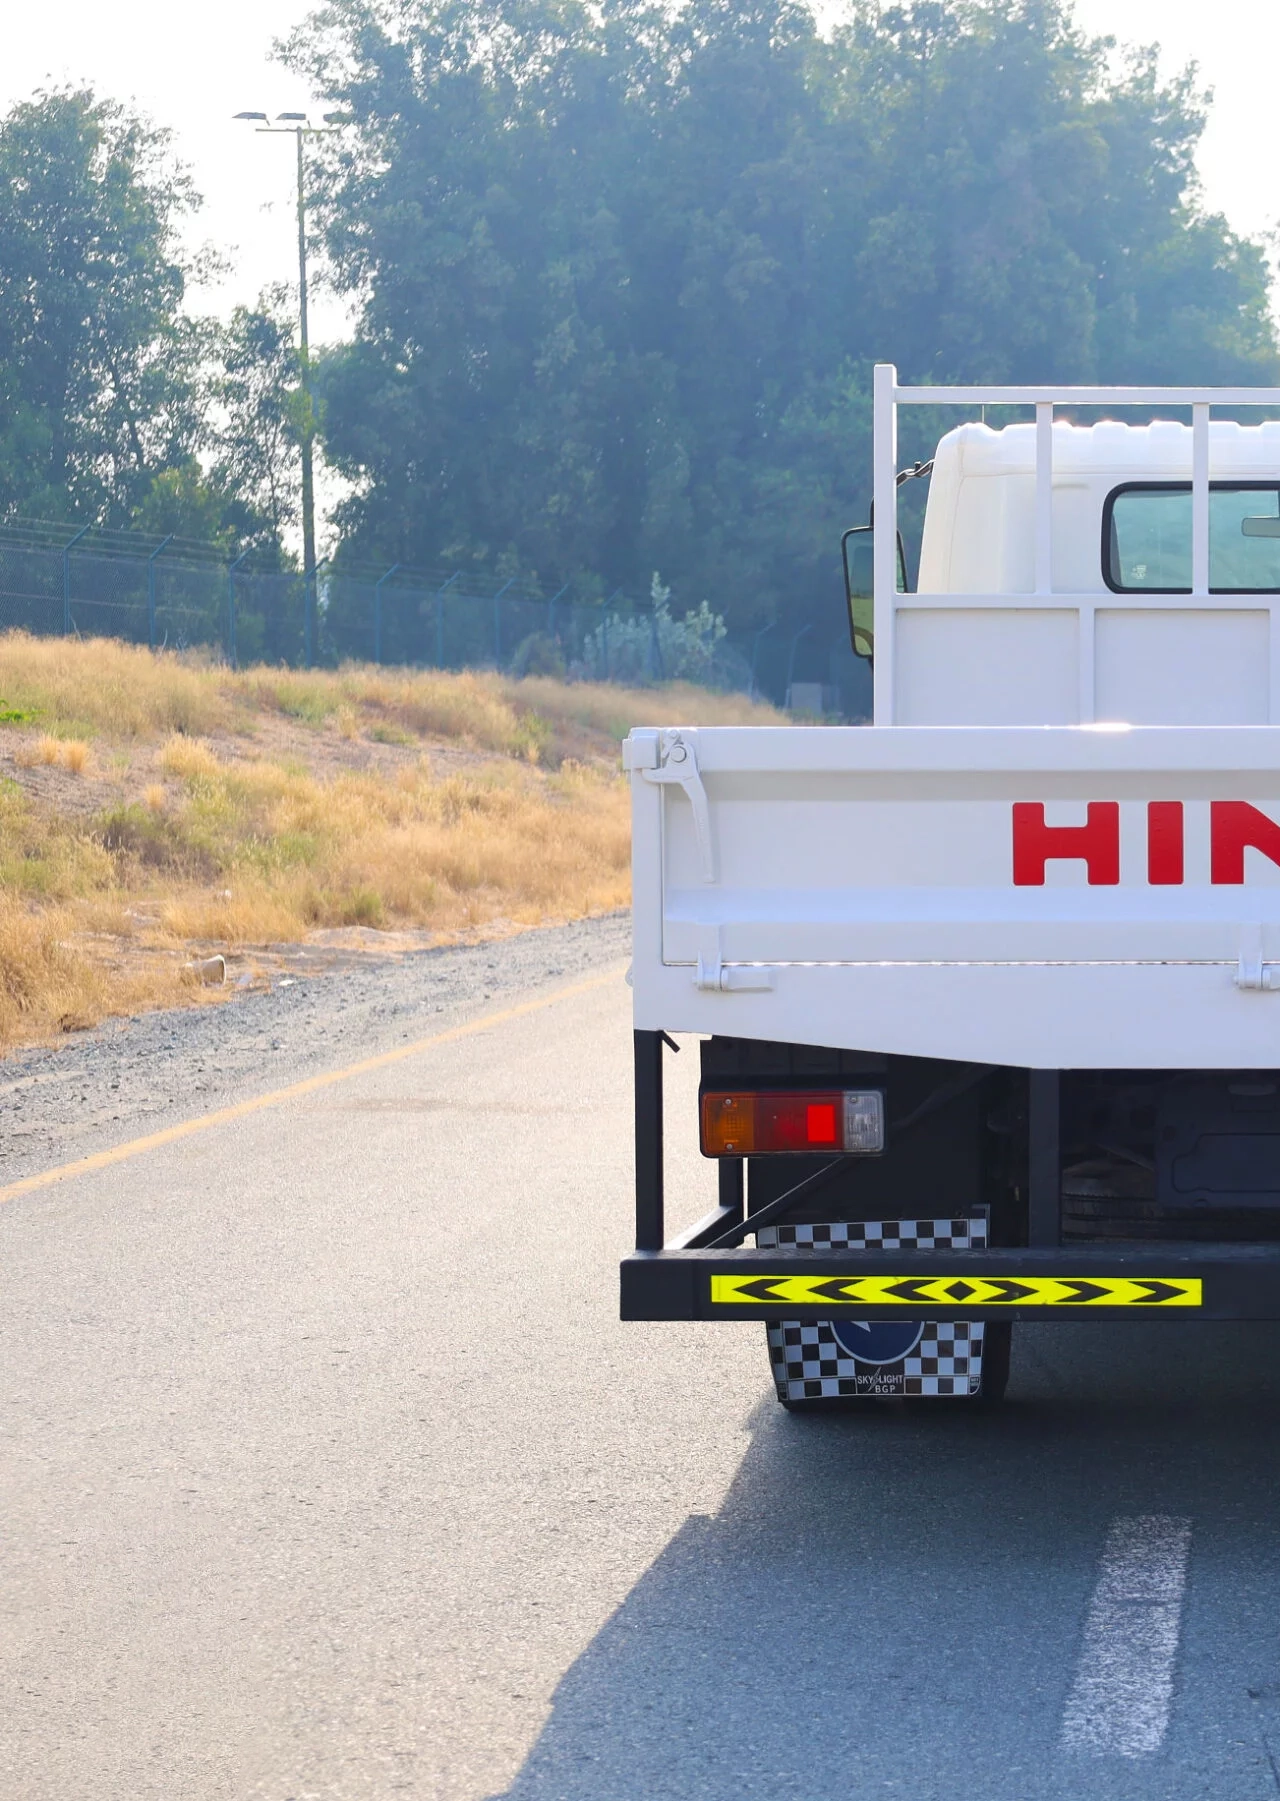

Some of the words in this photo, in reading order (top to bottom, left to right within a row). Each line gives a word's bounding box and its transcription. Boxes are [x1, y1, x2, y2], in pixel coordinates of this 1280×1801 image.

[857, 1375, 873, 1384] SKY
[879, 1374, 903, 1384] LIGHT
[875, 1384, 896, 1393] BGP
